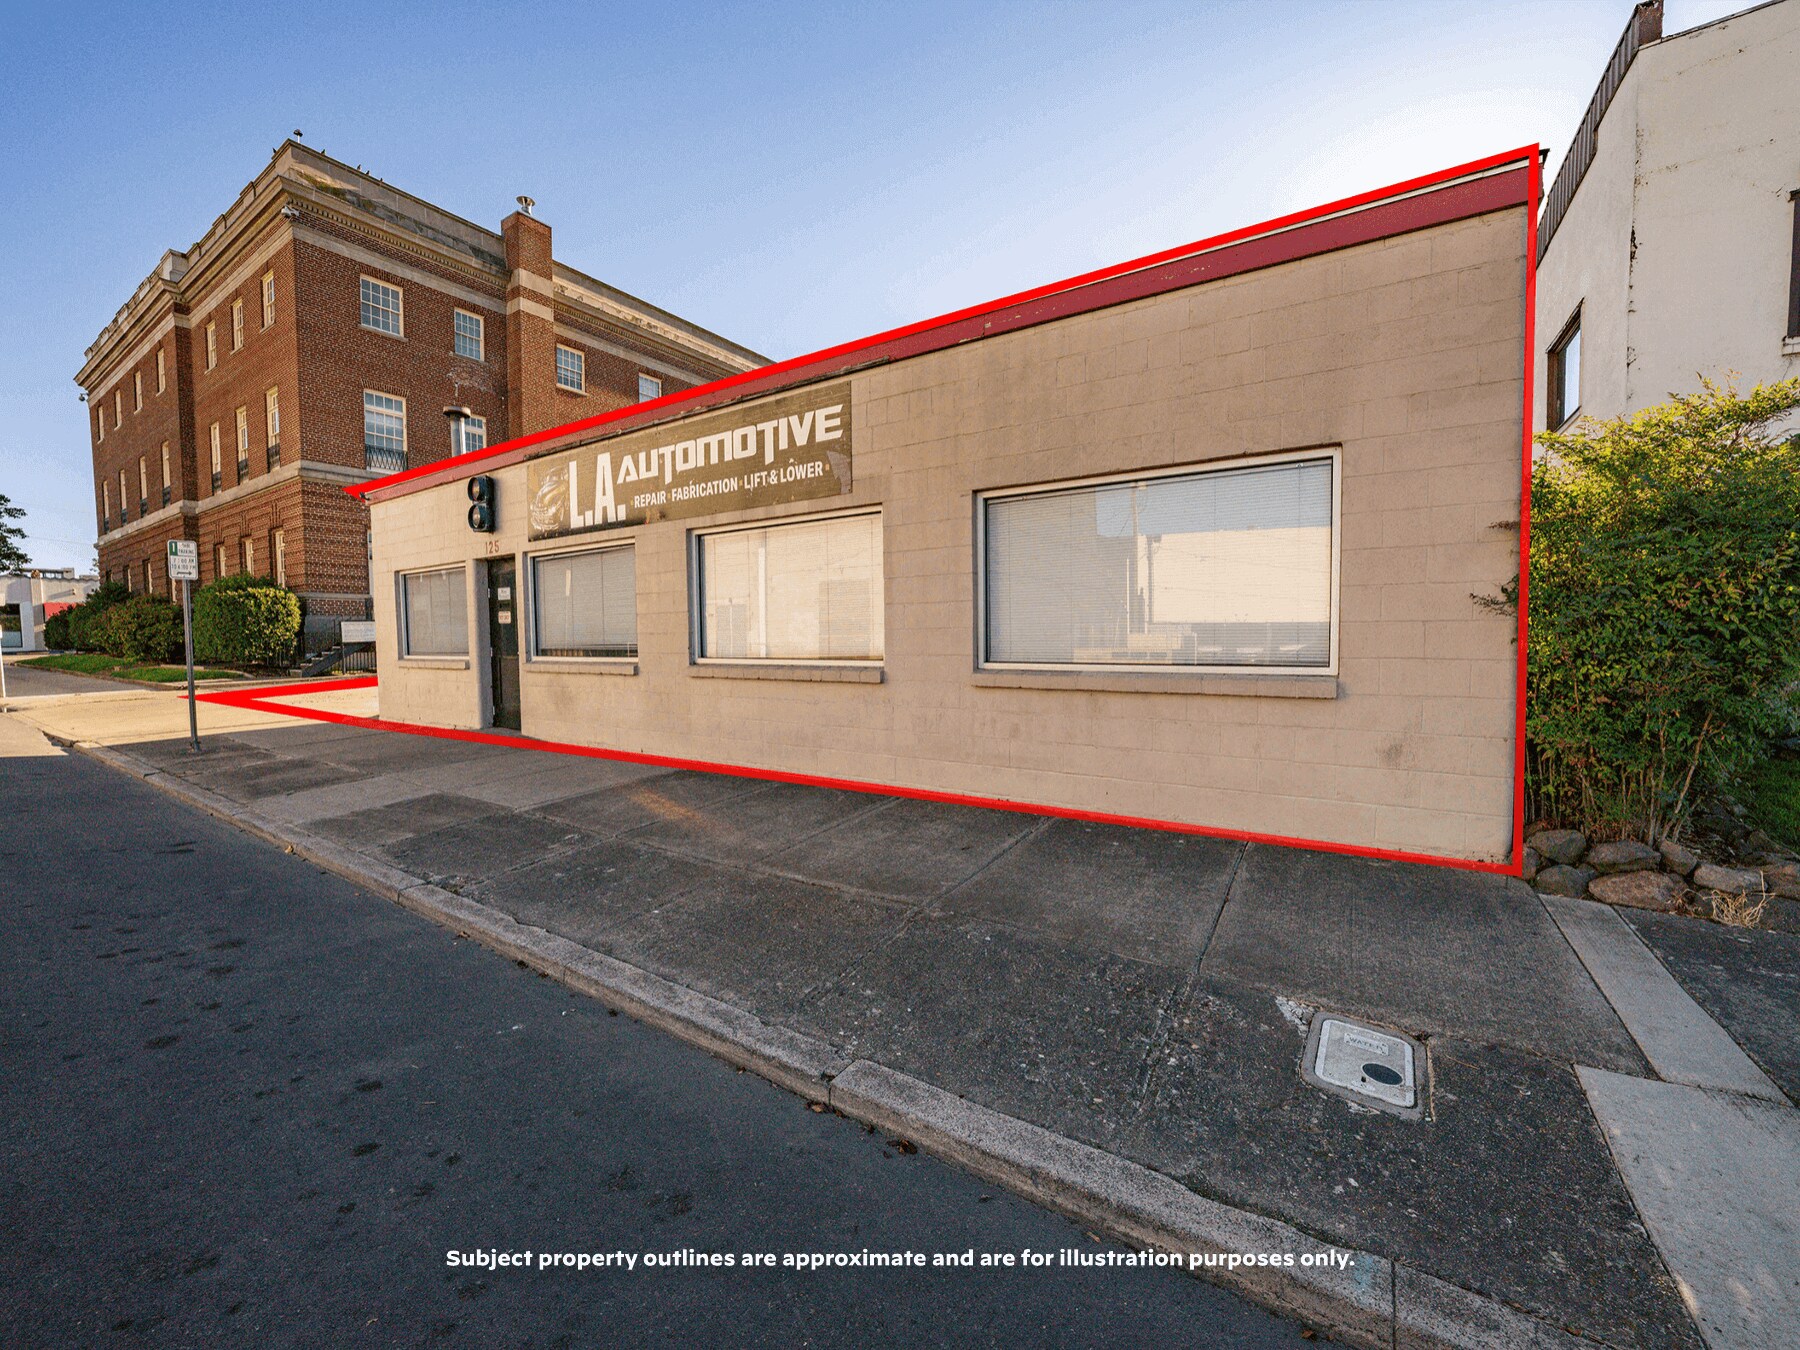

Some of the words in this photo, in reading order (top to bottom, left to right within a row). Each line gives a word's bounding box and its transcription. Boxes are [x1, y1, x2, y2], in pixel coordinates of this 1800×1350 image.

[569, 452, 627, 529] L.A.
[617, 404, 844, 485] AUTOMOTIVE
[634, 490, 667, 509] REPAIR
[671, 478, 739, 502] FABRICATION
[744, 470, 769, 490] LIFT
[769, 469, 779, 485] &
[780, 461, 824, 484] LOWER
[485, 540, 500, 555] 125
